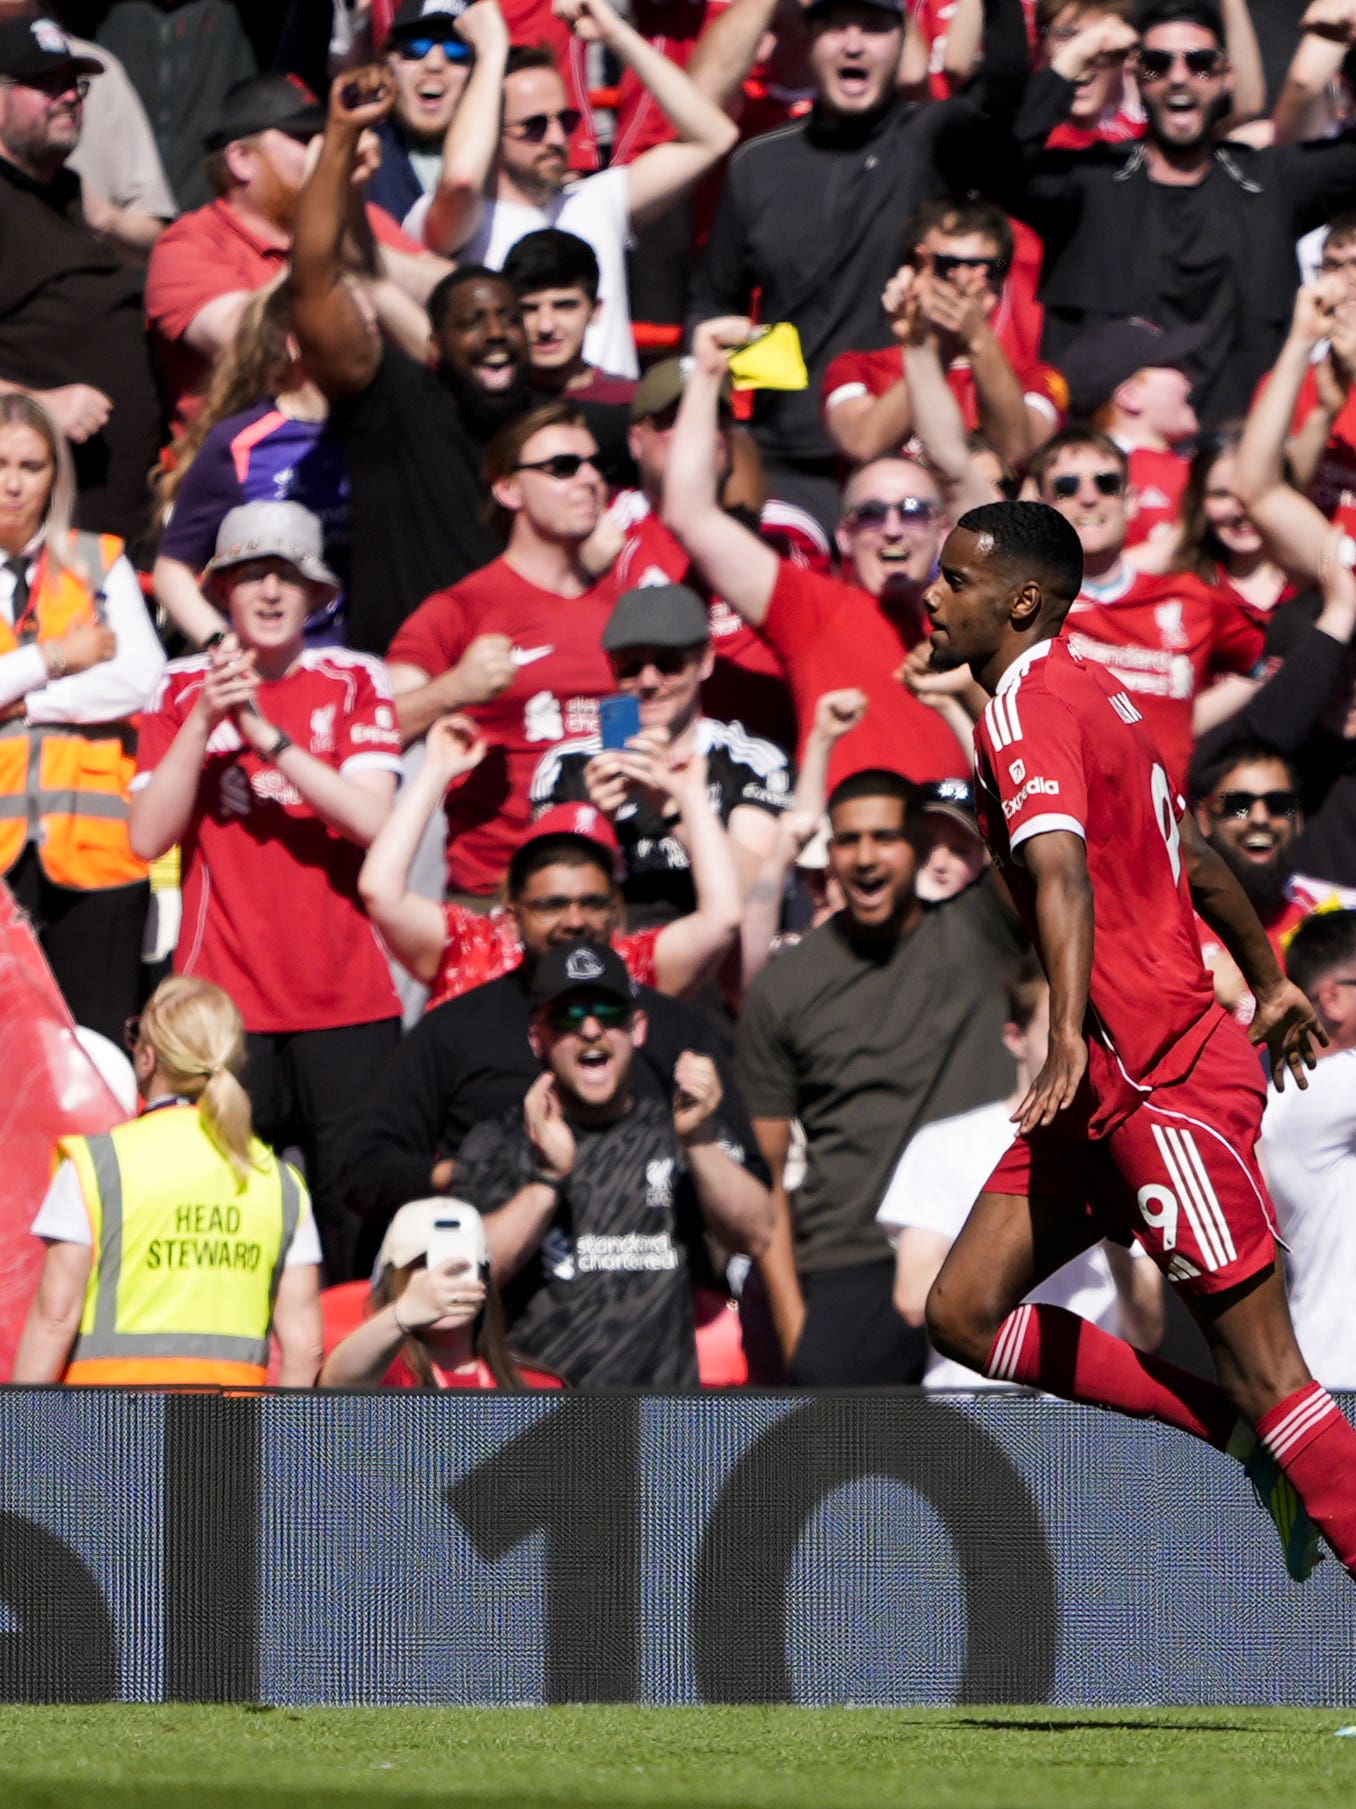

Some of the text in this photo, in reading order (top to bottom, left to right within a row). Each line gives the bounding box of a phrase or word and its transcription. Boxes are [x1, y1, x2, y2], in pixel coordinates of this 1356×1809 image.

[176, 1205, 241, 1233] HEAD
[1137, 1184, 1179, 1251] 9
[147, 1240, 261, 1271] STEWARD
[445, 1395, 1058, 1705] 10
